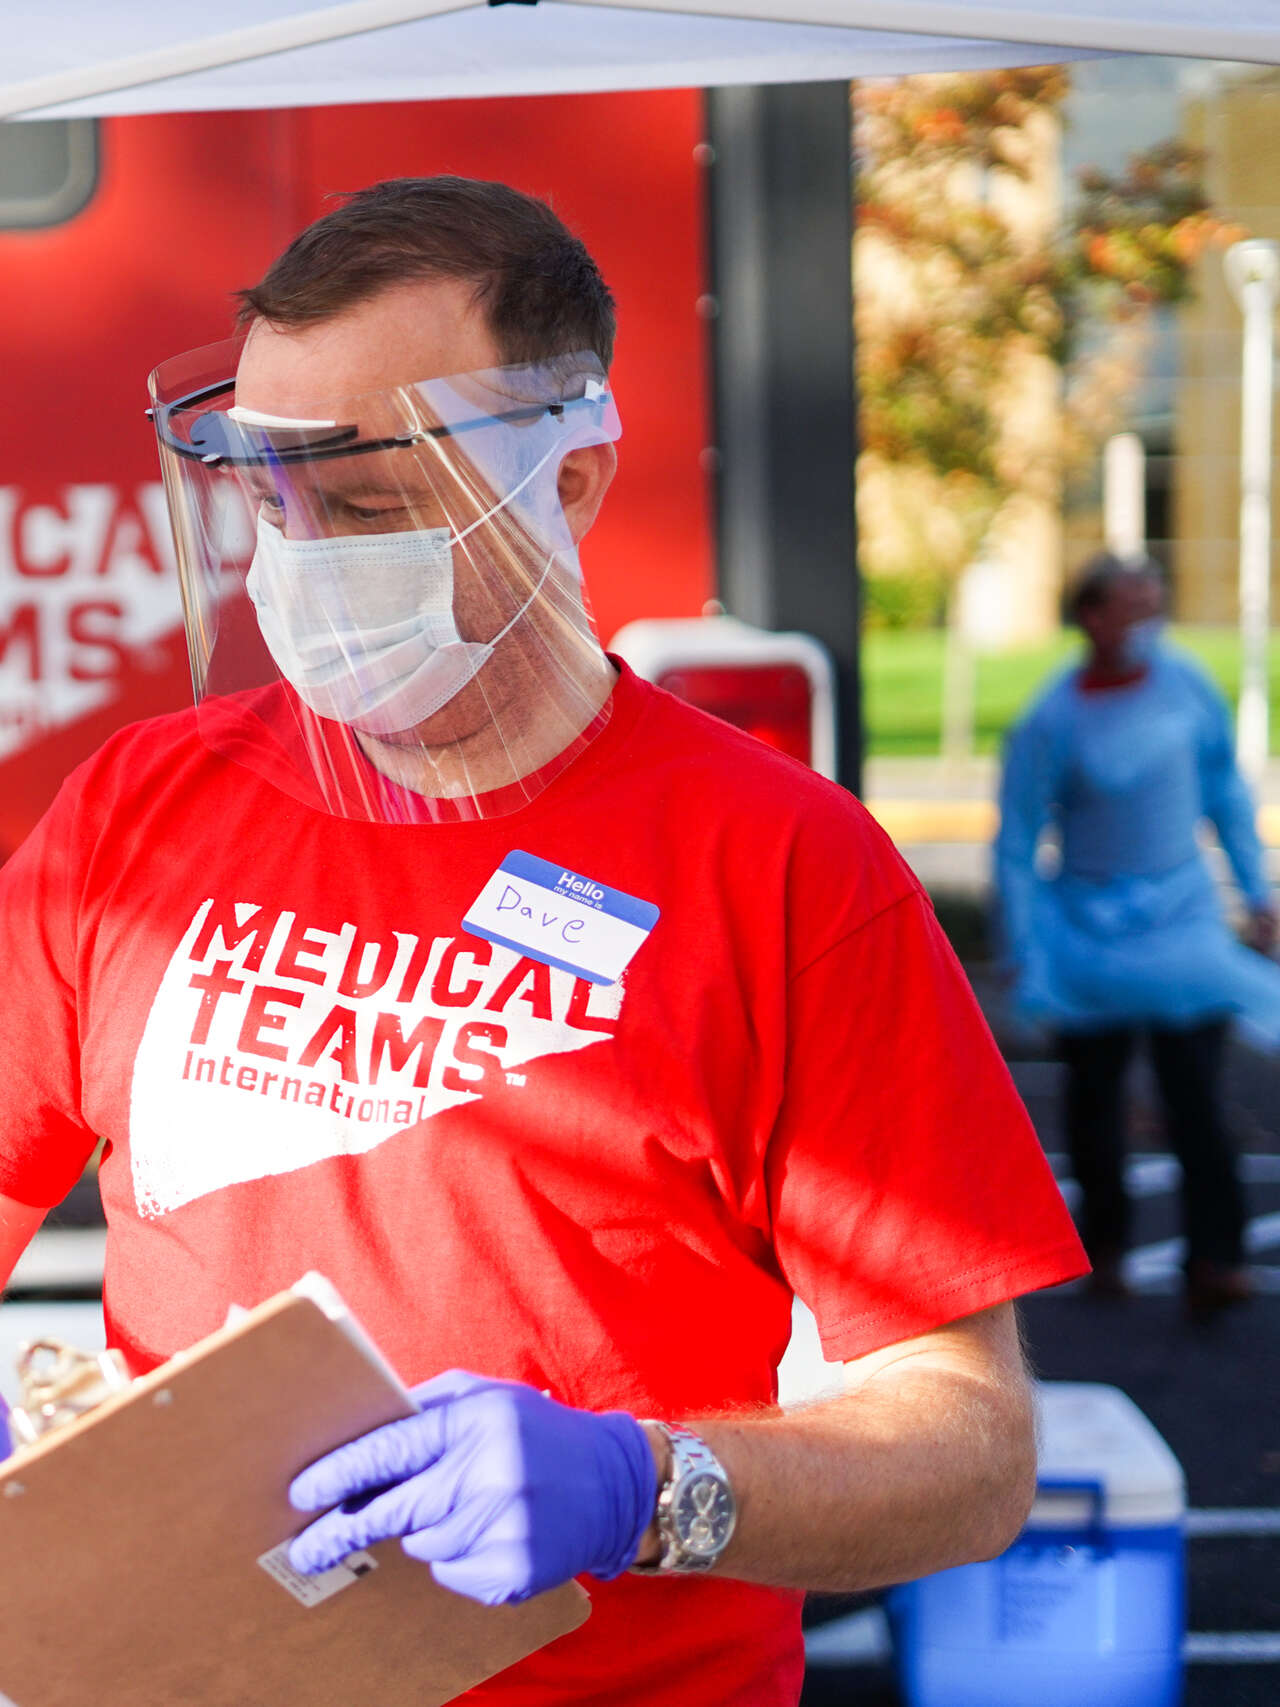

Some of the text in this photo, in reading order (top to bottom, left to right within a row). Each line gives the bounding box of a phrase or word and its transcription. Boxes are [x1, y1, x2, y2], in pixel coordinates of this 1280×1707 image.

[496, 884, 586, 943] Dave
[553, 886, 569, 897] my
[568, 892, 594, 905] name
[557, 871, 605, 900] Hello
[188, 902, 618, 1034] MEDICAL
[188, 962, 508, 1093] TEAMS
[182, 1050, 426, 1125] International
